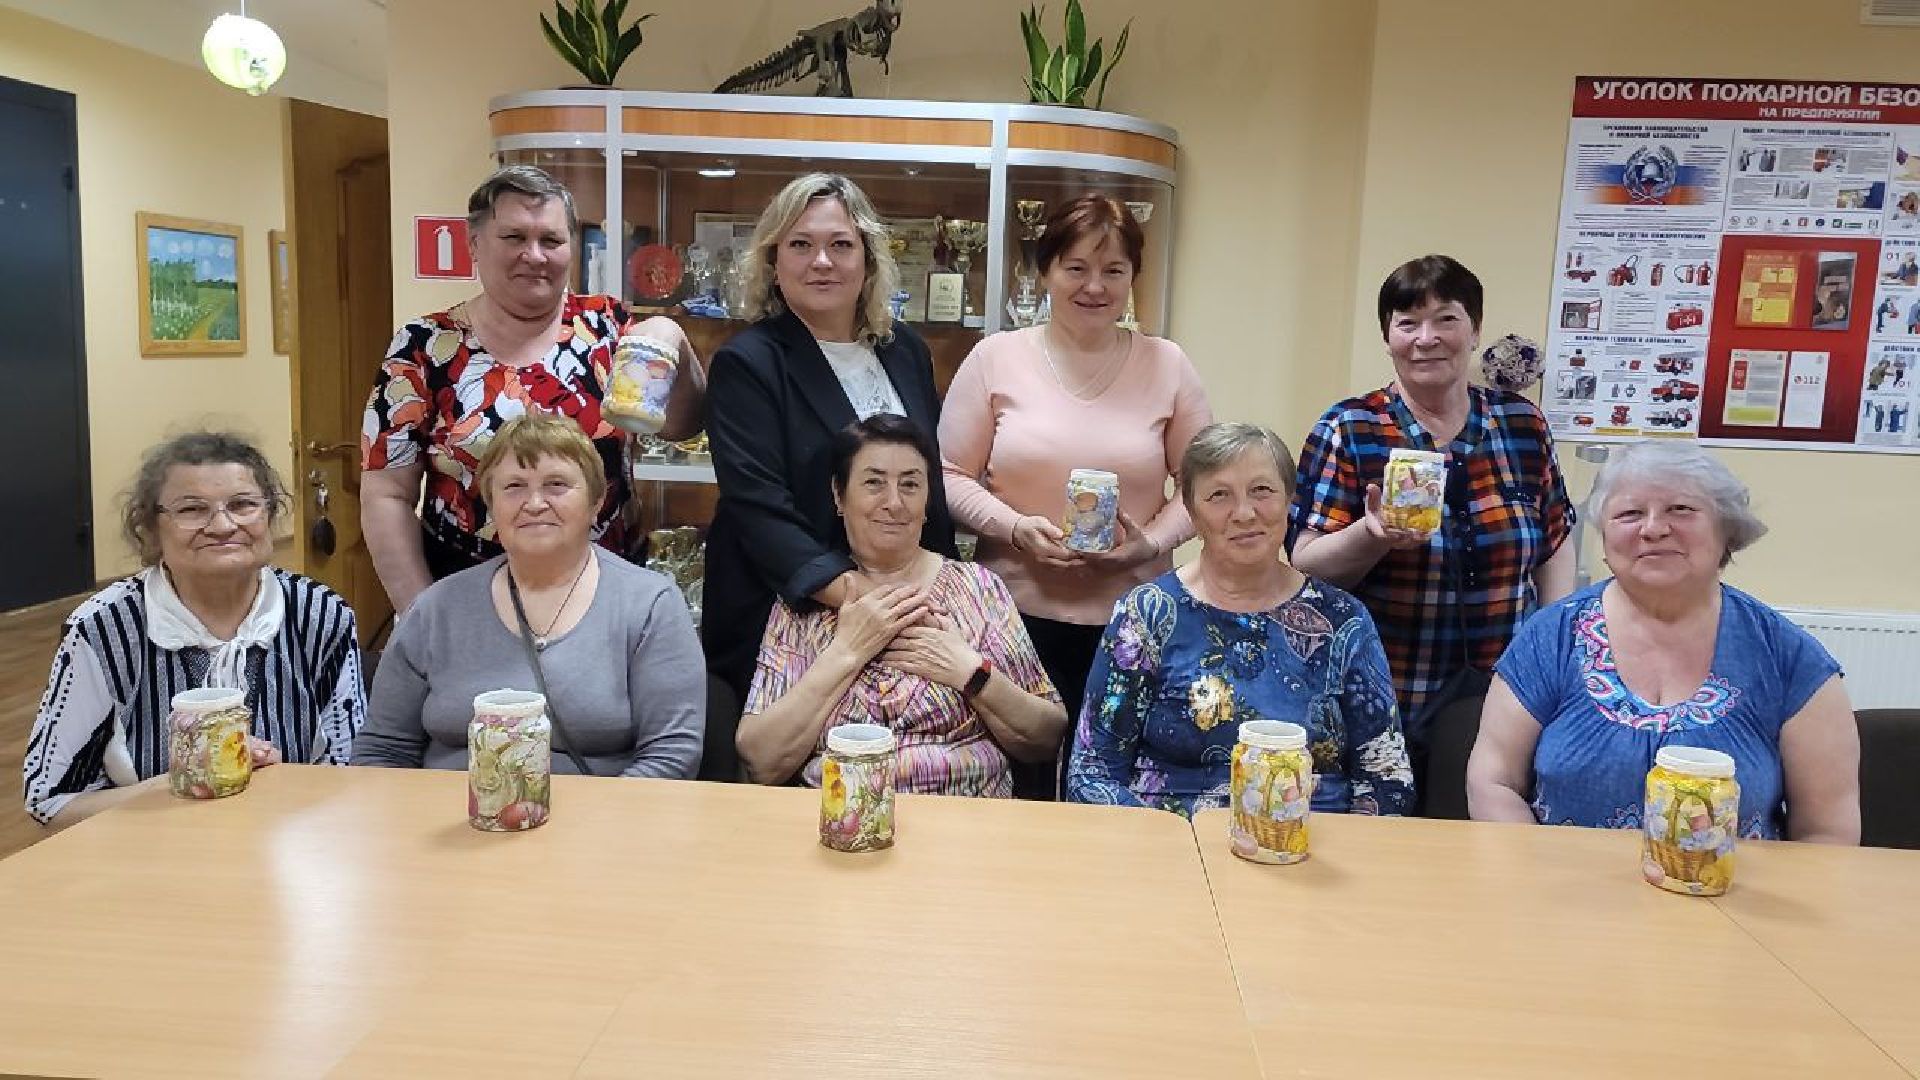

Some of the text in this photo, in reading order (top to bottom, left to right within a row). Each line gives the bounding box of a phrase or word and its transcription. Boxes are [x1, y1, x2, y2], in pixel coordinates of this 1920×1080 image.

[1593, 81, 1920, 107] УГОЛОК ПОЖАРНОЙ БЕЗО
[1759, 107, 1882, 121] НА ПРЕДПРИЯТИИ
